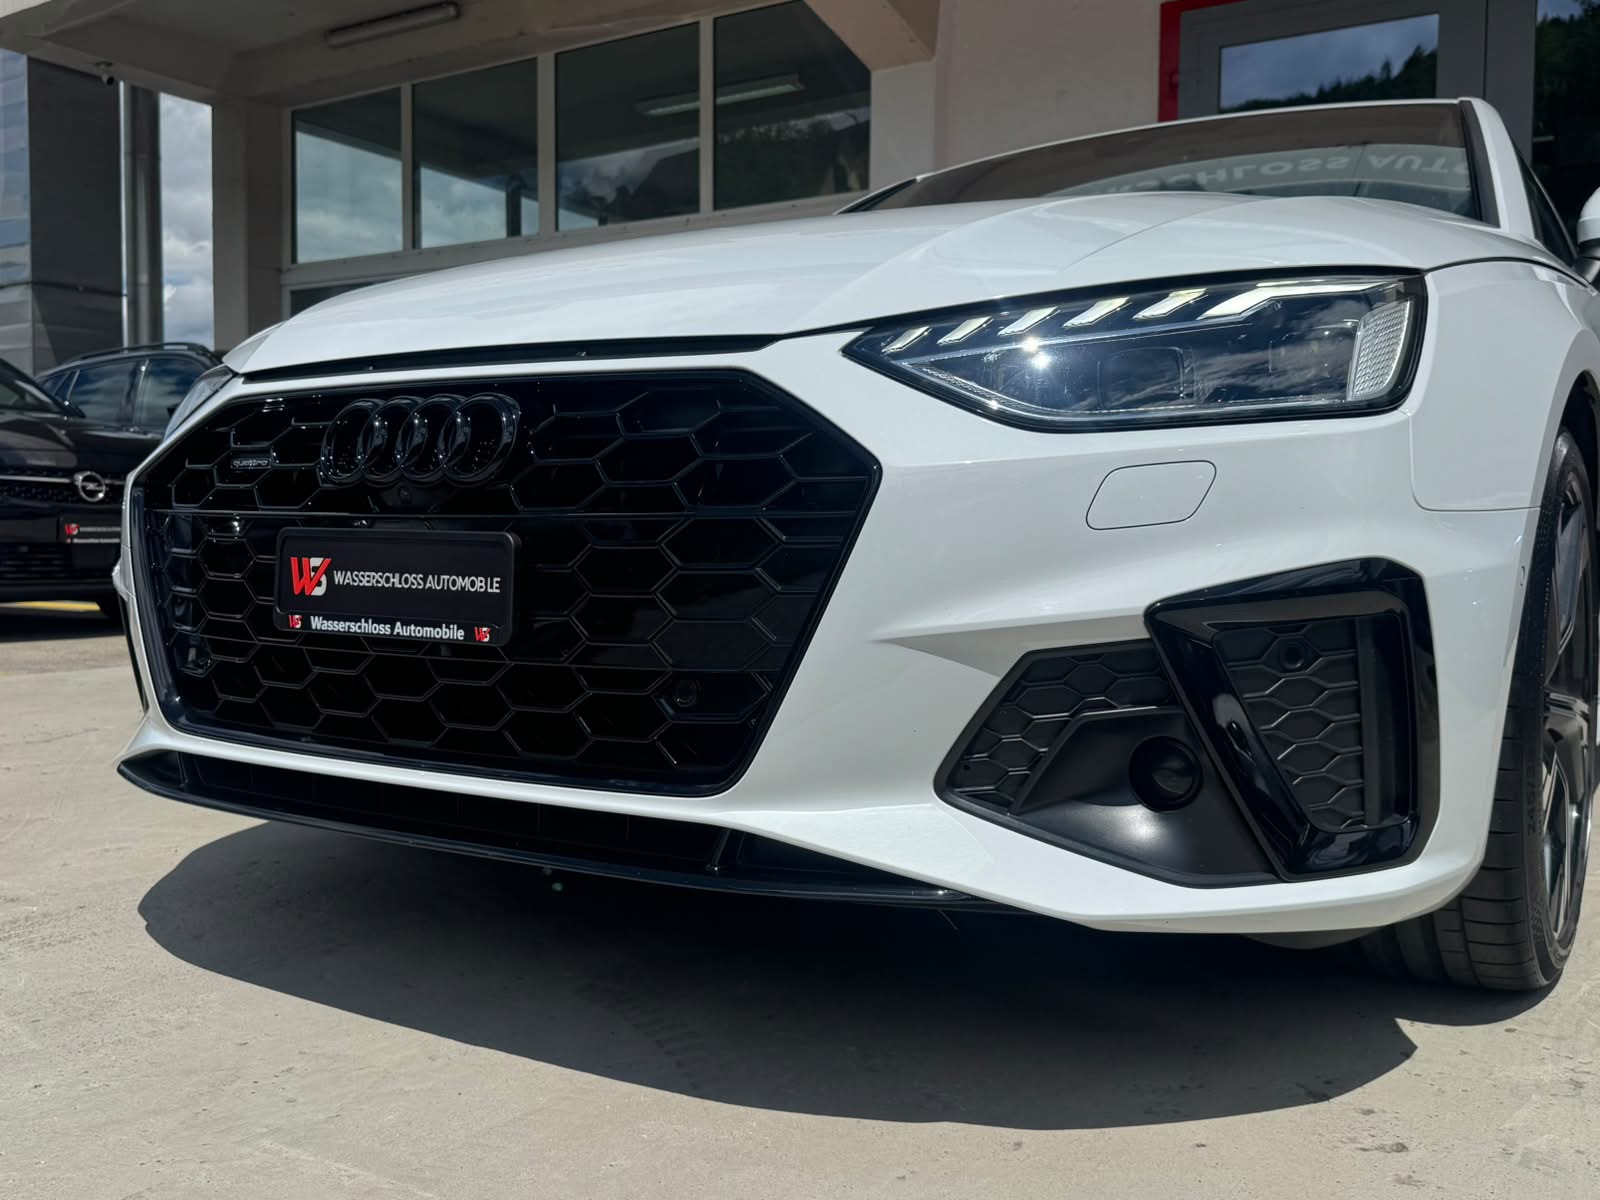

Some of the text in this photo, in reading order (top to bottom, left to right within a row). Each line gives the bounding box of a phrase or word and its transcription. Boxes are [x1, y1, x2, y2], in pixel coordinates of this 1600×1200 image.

[333, 569, 425, 590] WASSERSCHLOSS
[425, 574, 501, 593] AUTOMOBLE
[310, 615, 391, 635] Wasserschloss
[393, 621, 465, 640] Automobile
